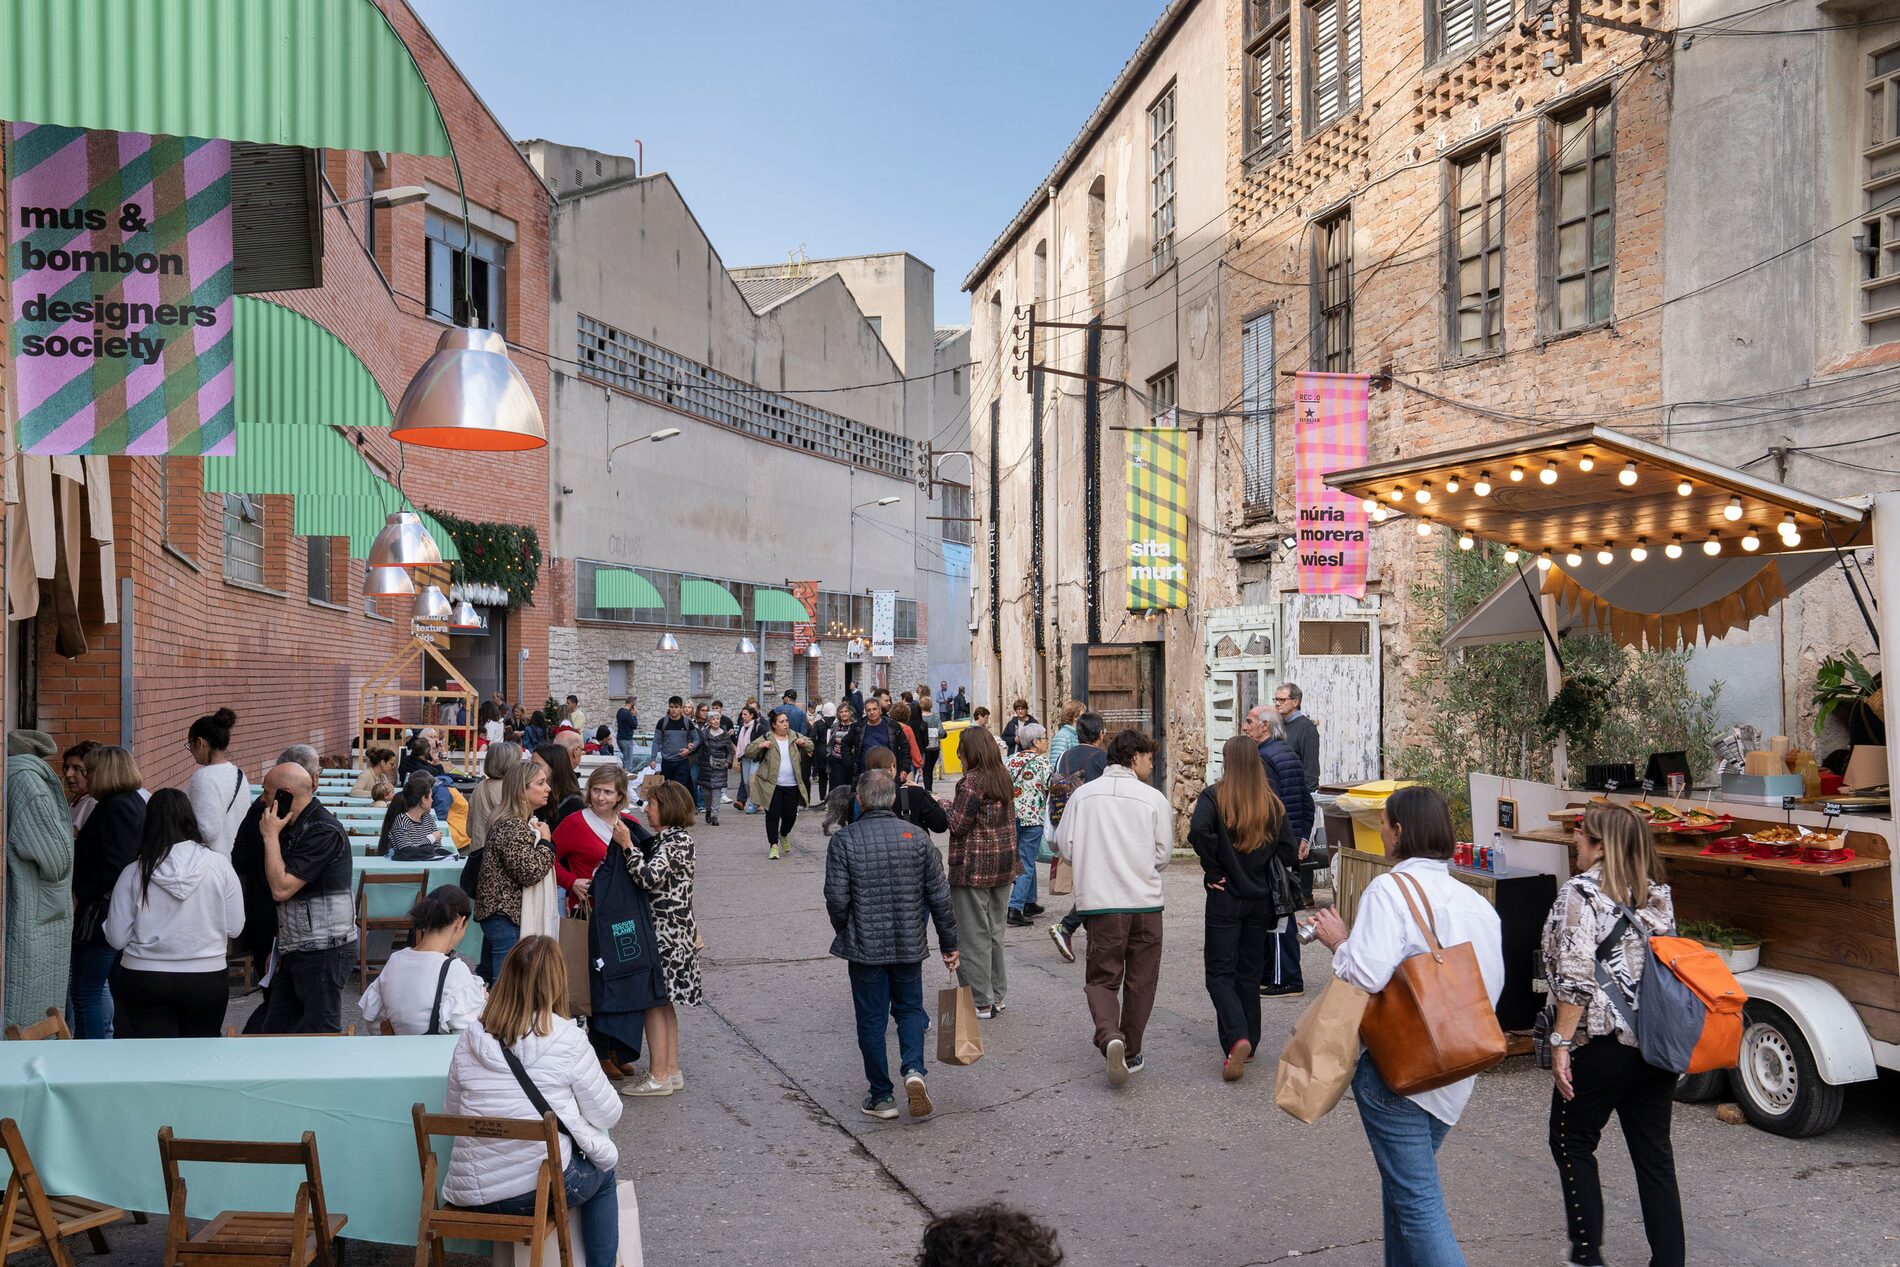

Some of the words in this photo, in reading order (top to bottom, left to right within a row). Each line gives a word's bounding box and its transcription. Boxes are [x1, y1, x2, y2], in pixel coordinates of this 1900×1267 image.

[21, 206, 106, 230] mus
[118, 203, 148, 233] &
[21, 241, 183, 275] bombon
[22, 293, 217, 331] designers
[22, 329, 166, 365] society
[1300, 505, 1345, 521] núria
[1301, 529, 1364, 541] morera
[1131, 539, 1170, 556] sita
[1301, 551, 1344, 567] wiesl
[1131, 563, 1184, 580] murt
[416, 624, 448, 632] textura
[614, 932, 641, 962] B
